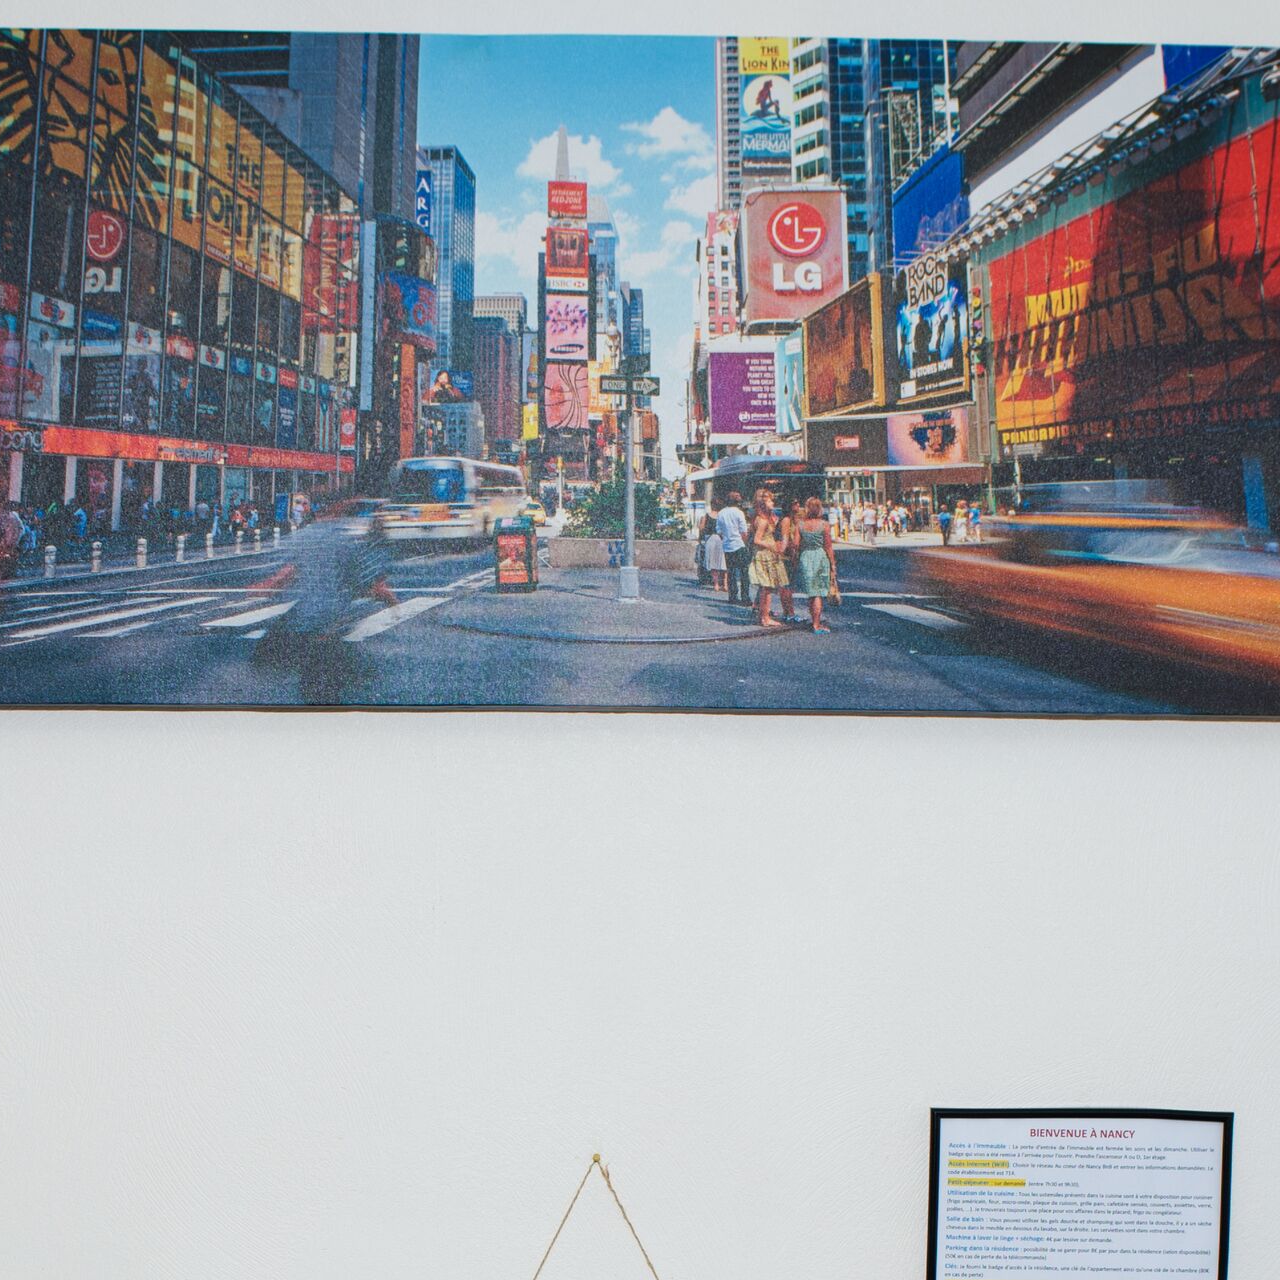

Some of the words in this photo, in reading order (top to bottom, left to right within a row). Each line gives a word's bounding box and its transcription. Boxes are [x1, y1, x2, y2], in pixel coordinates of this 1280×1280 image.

[761, 46, 778, 56] THE
[742, 58, 768, 71] LION
[773, 262, 823, 292] LG
[909, 275, 946, 307] BAND
[635, 382, 651, 390] WAY
[1029, 1128, 1087, 1138] BIENVENUE
[1090, 1127, 1097, 1139] À
[1099, 1129, 1135, 1139] NANCY
